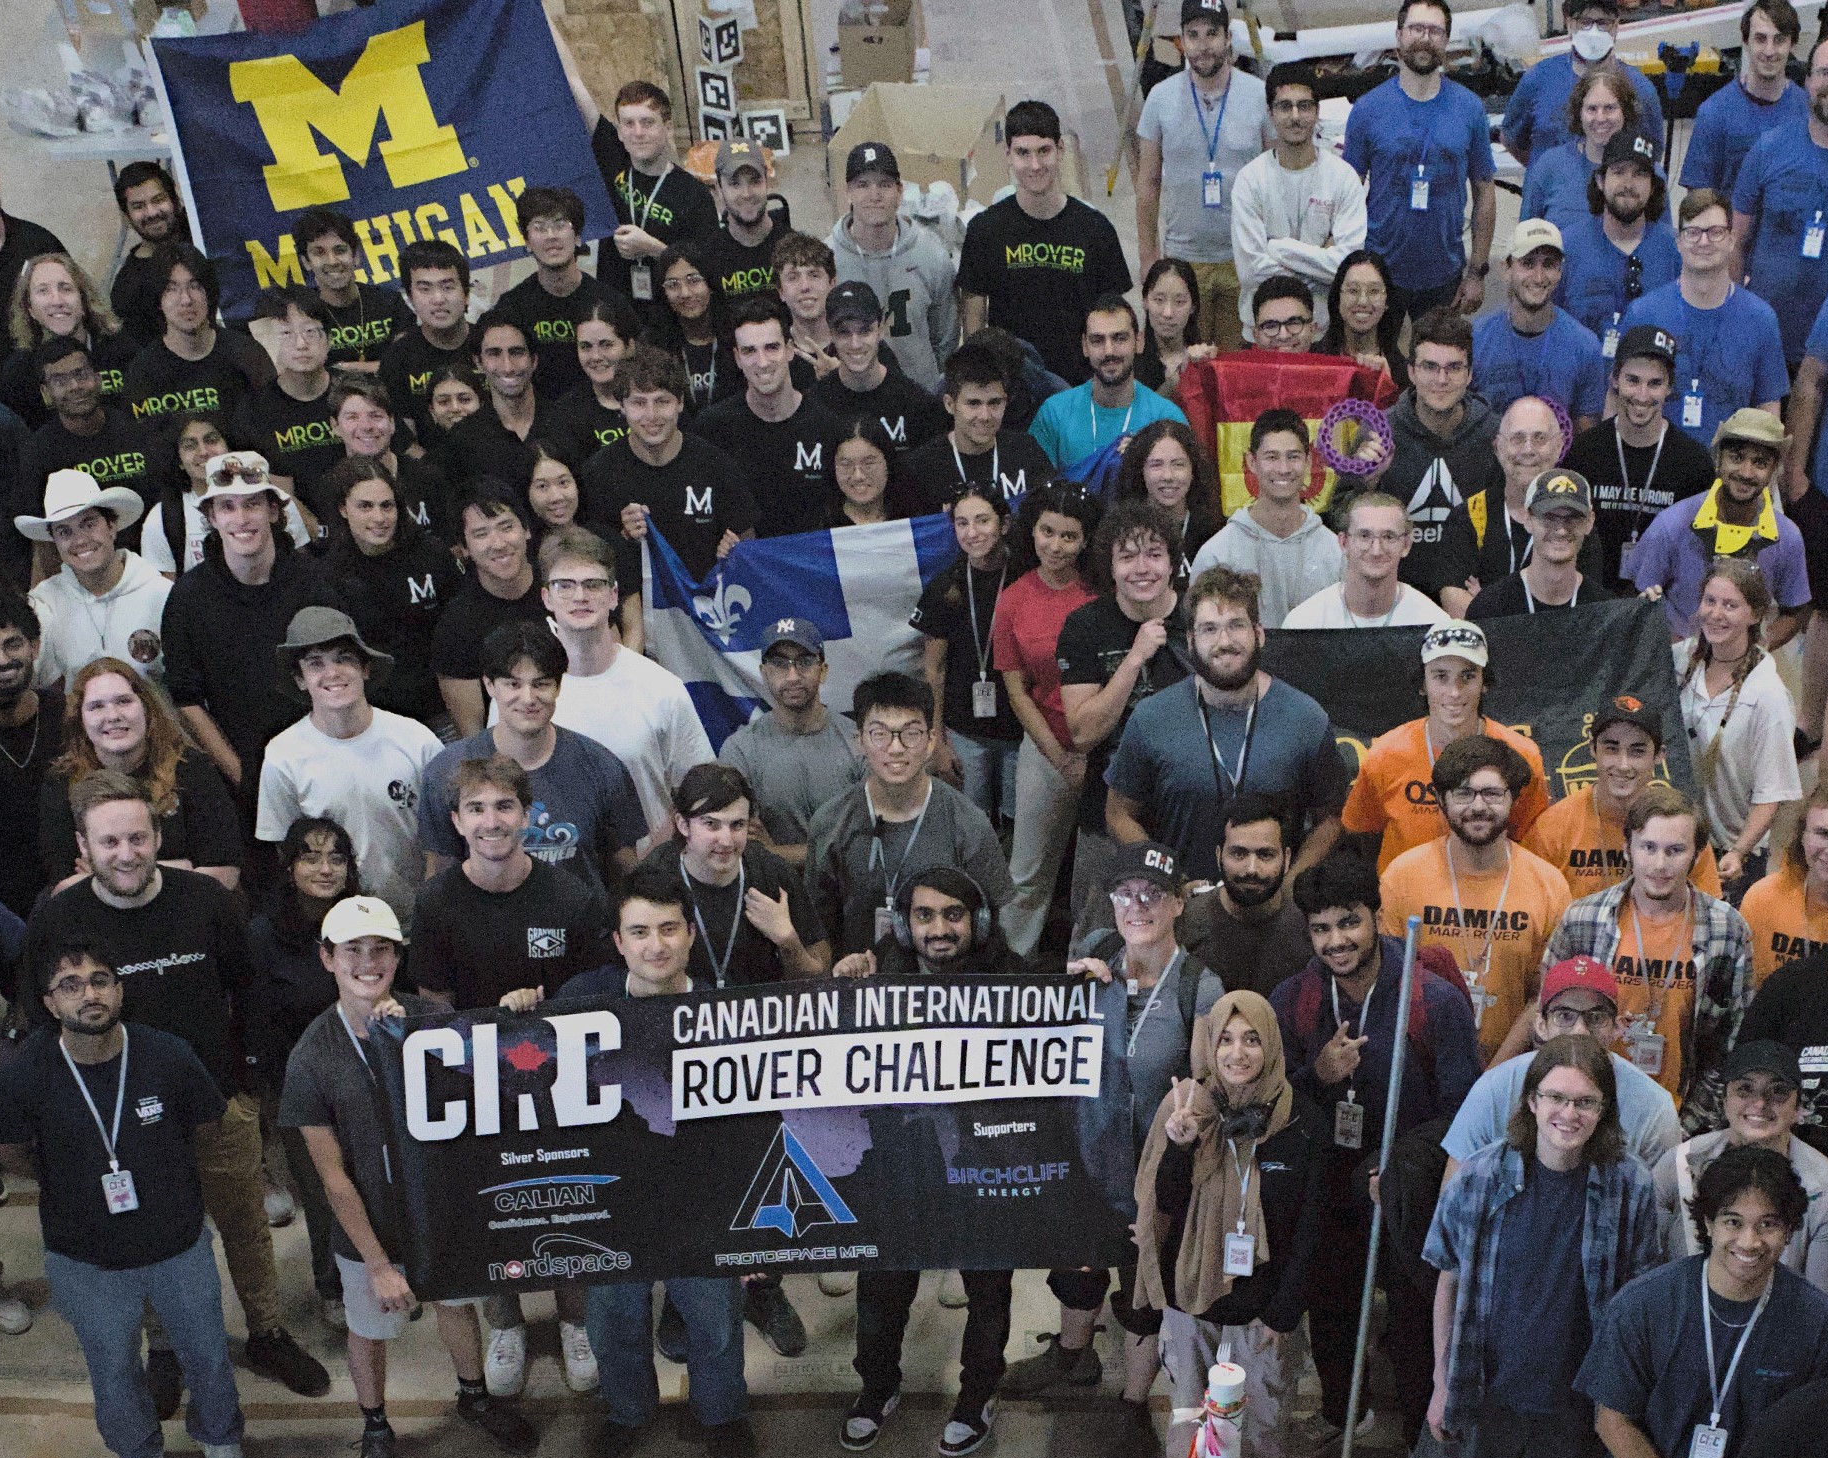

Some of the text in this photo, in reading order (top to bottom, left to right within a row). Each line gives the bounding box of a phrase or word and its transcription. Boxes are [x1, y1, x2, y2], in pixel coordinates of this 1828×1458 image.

[229, 20, 470, 212] M
[1633, 136, 1654, 158] CIC
[243, 176, 530, 289] MHIGAN
[1005, 243, 1086, 268] MROVER
[721, 264, 775, 294] MROV
[329, 316, 393, 348] ROVER
[1654, 331, 1675, 355] CIC
[131, 387, 220, 420] MROVER
[274, 421, 337, 453] MROV
[77, 451, 147, 481] ROVER
[1599, 485, 1620, 500] MAY
[1570, 848, 1629, 868] DAM
[1423, 905, 1530, 931] DAMRC
[527, 927, 566, 943] GRANVILLE
[1428, 927, 1522, 942] MAR ROVER
[528, 945, 565, 958] ISLAND
[1614, 955, 1698, 980] AMRC
[673, 981, 1105, 1043] CANADIAN INTERNATIONAL
[402, 1011, 622, 1142] CIRC
[682, 1036, 1092, 1109] ROVER CHALLENGE
[134, 1102, 164, 1119] VANS
[974, 1121, 1037, 1139] Supporters
[500, 1148, 590, 1166] Silver Sponsors
[946, 1162, 1071, 1185] BIRCHCLIFF
[493, 1183, 596, 1213] CALIAN
[977, 1186, 1043, 1198] ENERGY
[550, 1209, 611, 1225] Engineered.
[715, 1245, 879, 1266] PROTOSPACE MFG
